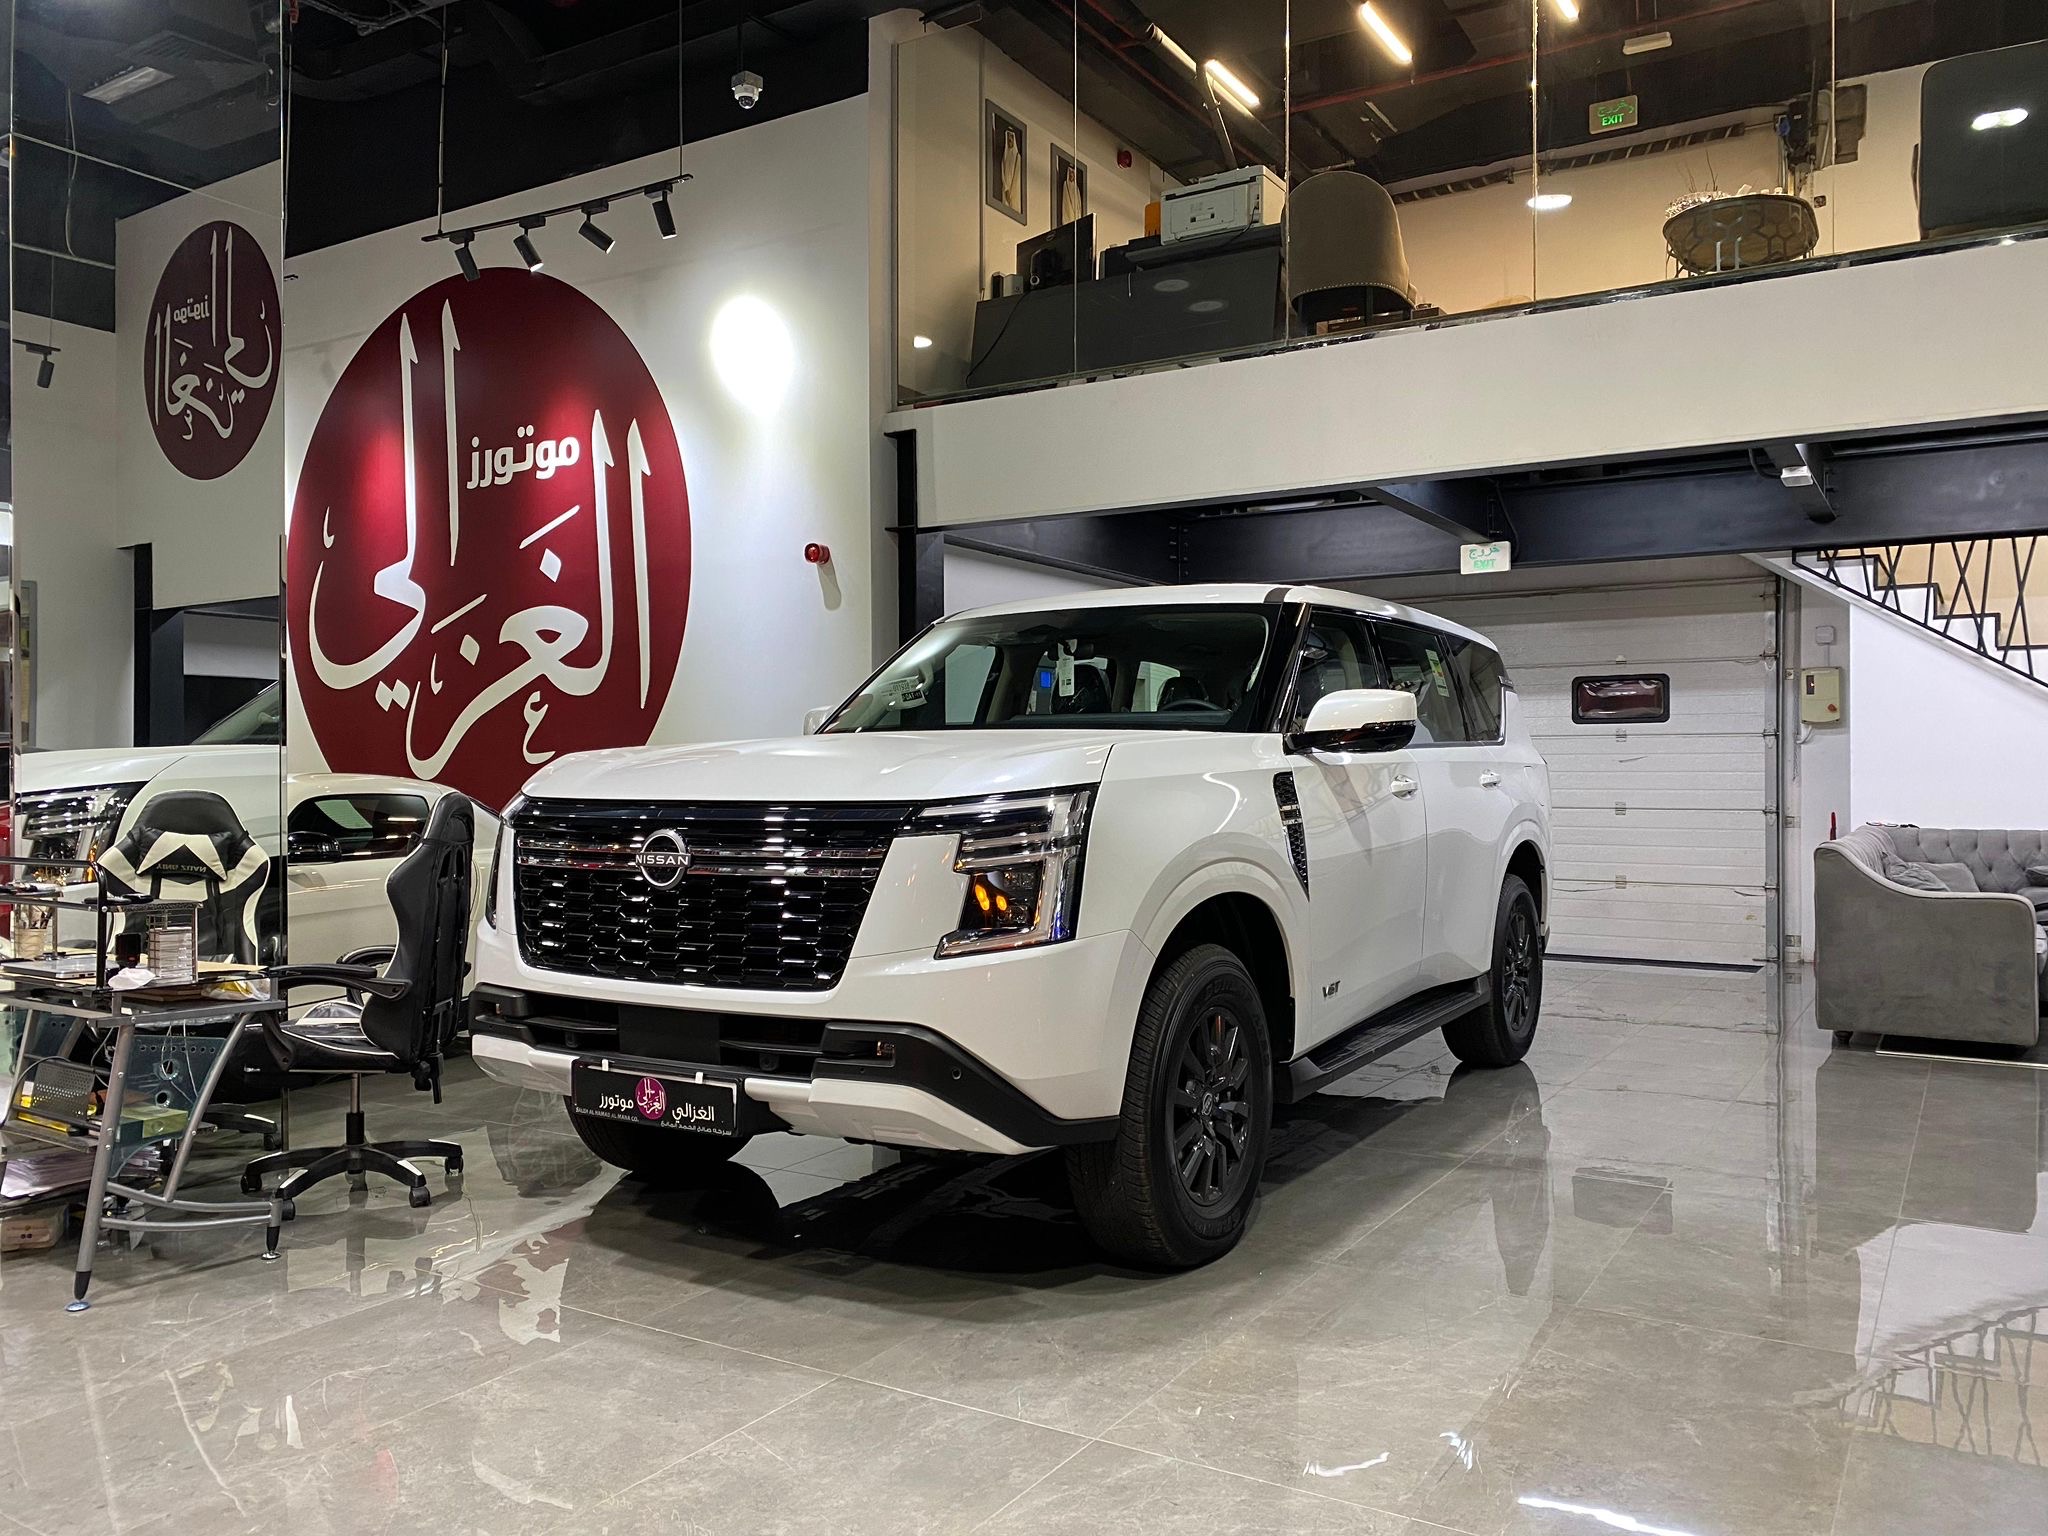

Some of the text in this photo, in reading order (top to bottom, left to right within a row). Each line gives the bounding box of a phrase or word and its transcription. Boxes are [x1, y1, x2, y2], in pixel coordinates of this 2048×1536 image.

[1602, 113, 1624, 126] EXIT
[466, 424, 580, 490] موتورز
[1468, 544, 1500, 560] خروج
[1473, 558, 1496, 569] EXIT
[635, 854, 689, 866] NISSAN
[598, 1092, 715, 1122] الغزالي موتورز
